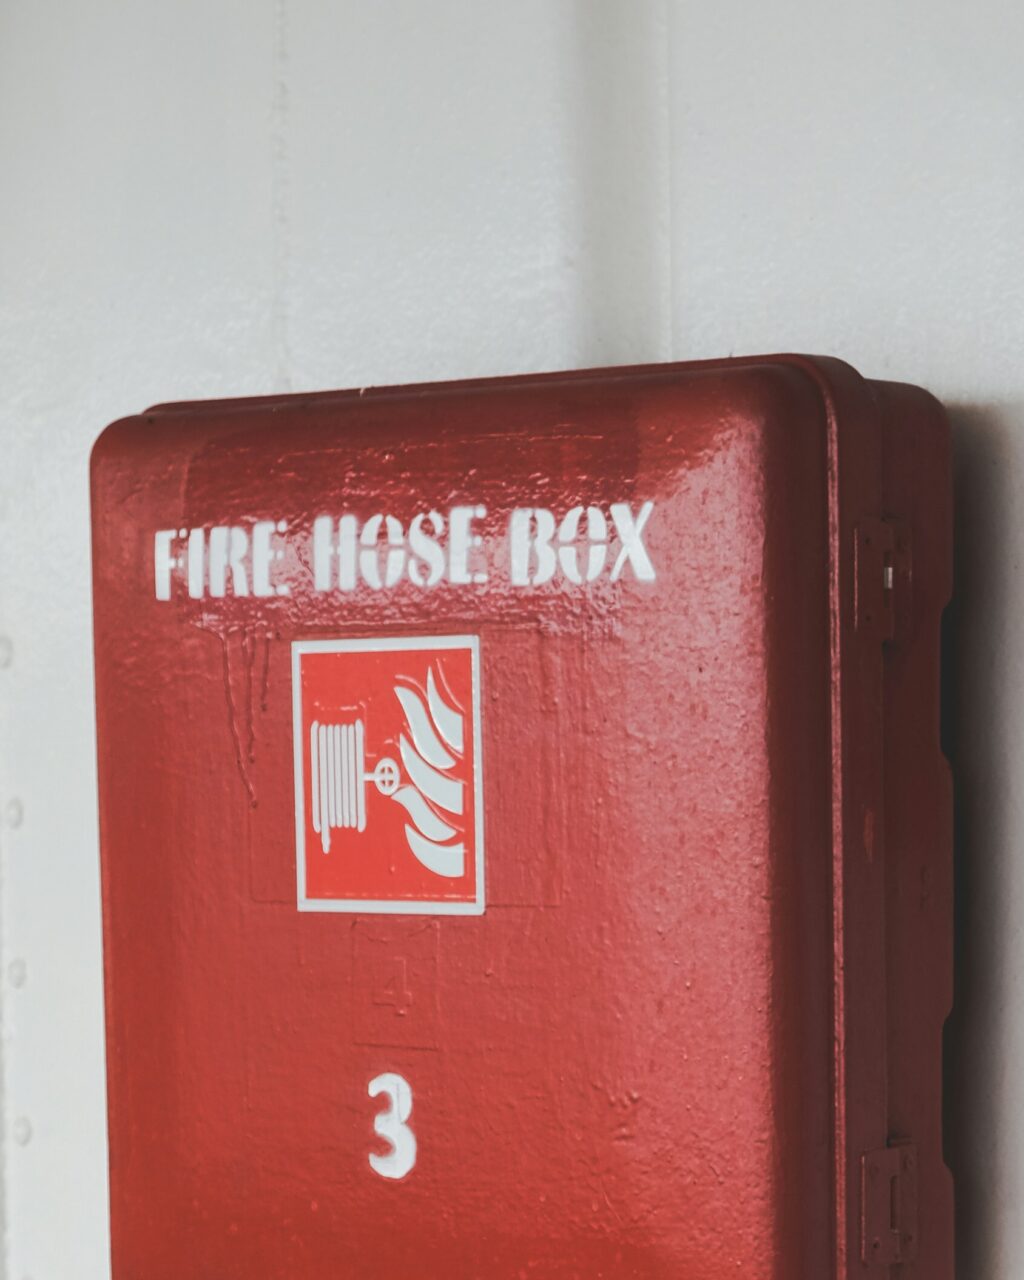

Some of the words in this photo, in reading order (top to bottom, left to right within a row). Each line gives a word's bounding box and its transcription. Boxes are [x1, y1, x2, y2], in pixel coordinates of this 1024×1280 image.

[154, 520, 289, 601] FIRE
[313, 504, 488, 591] HOSE
[510, 501, 656, 587] BOX
[367, 1072, 417, 1179] 3
